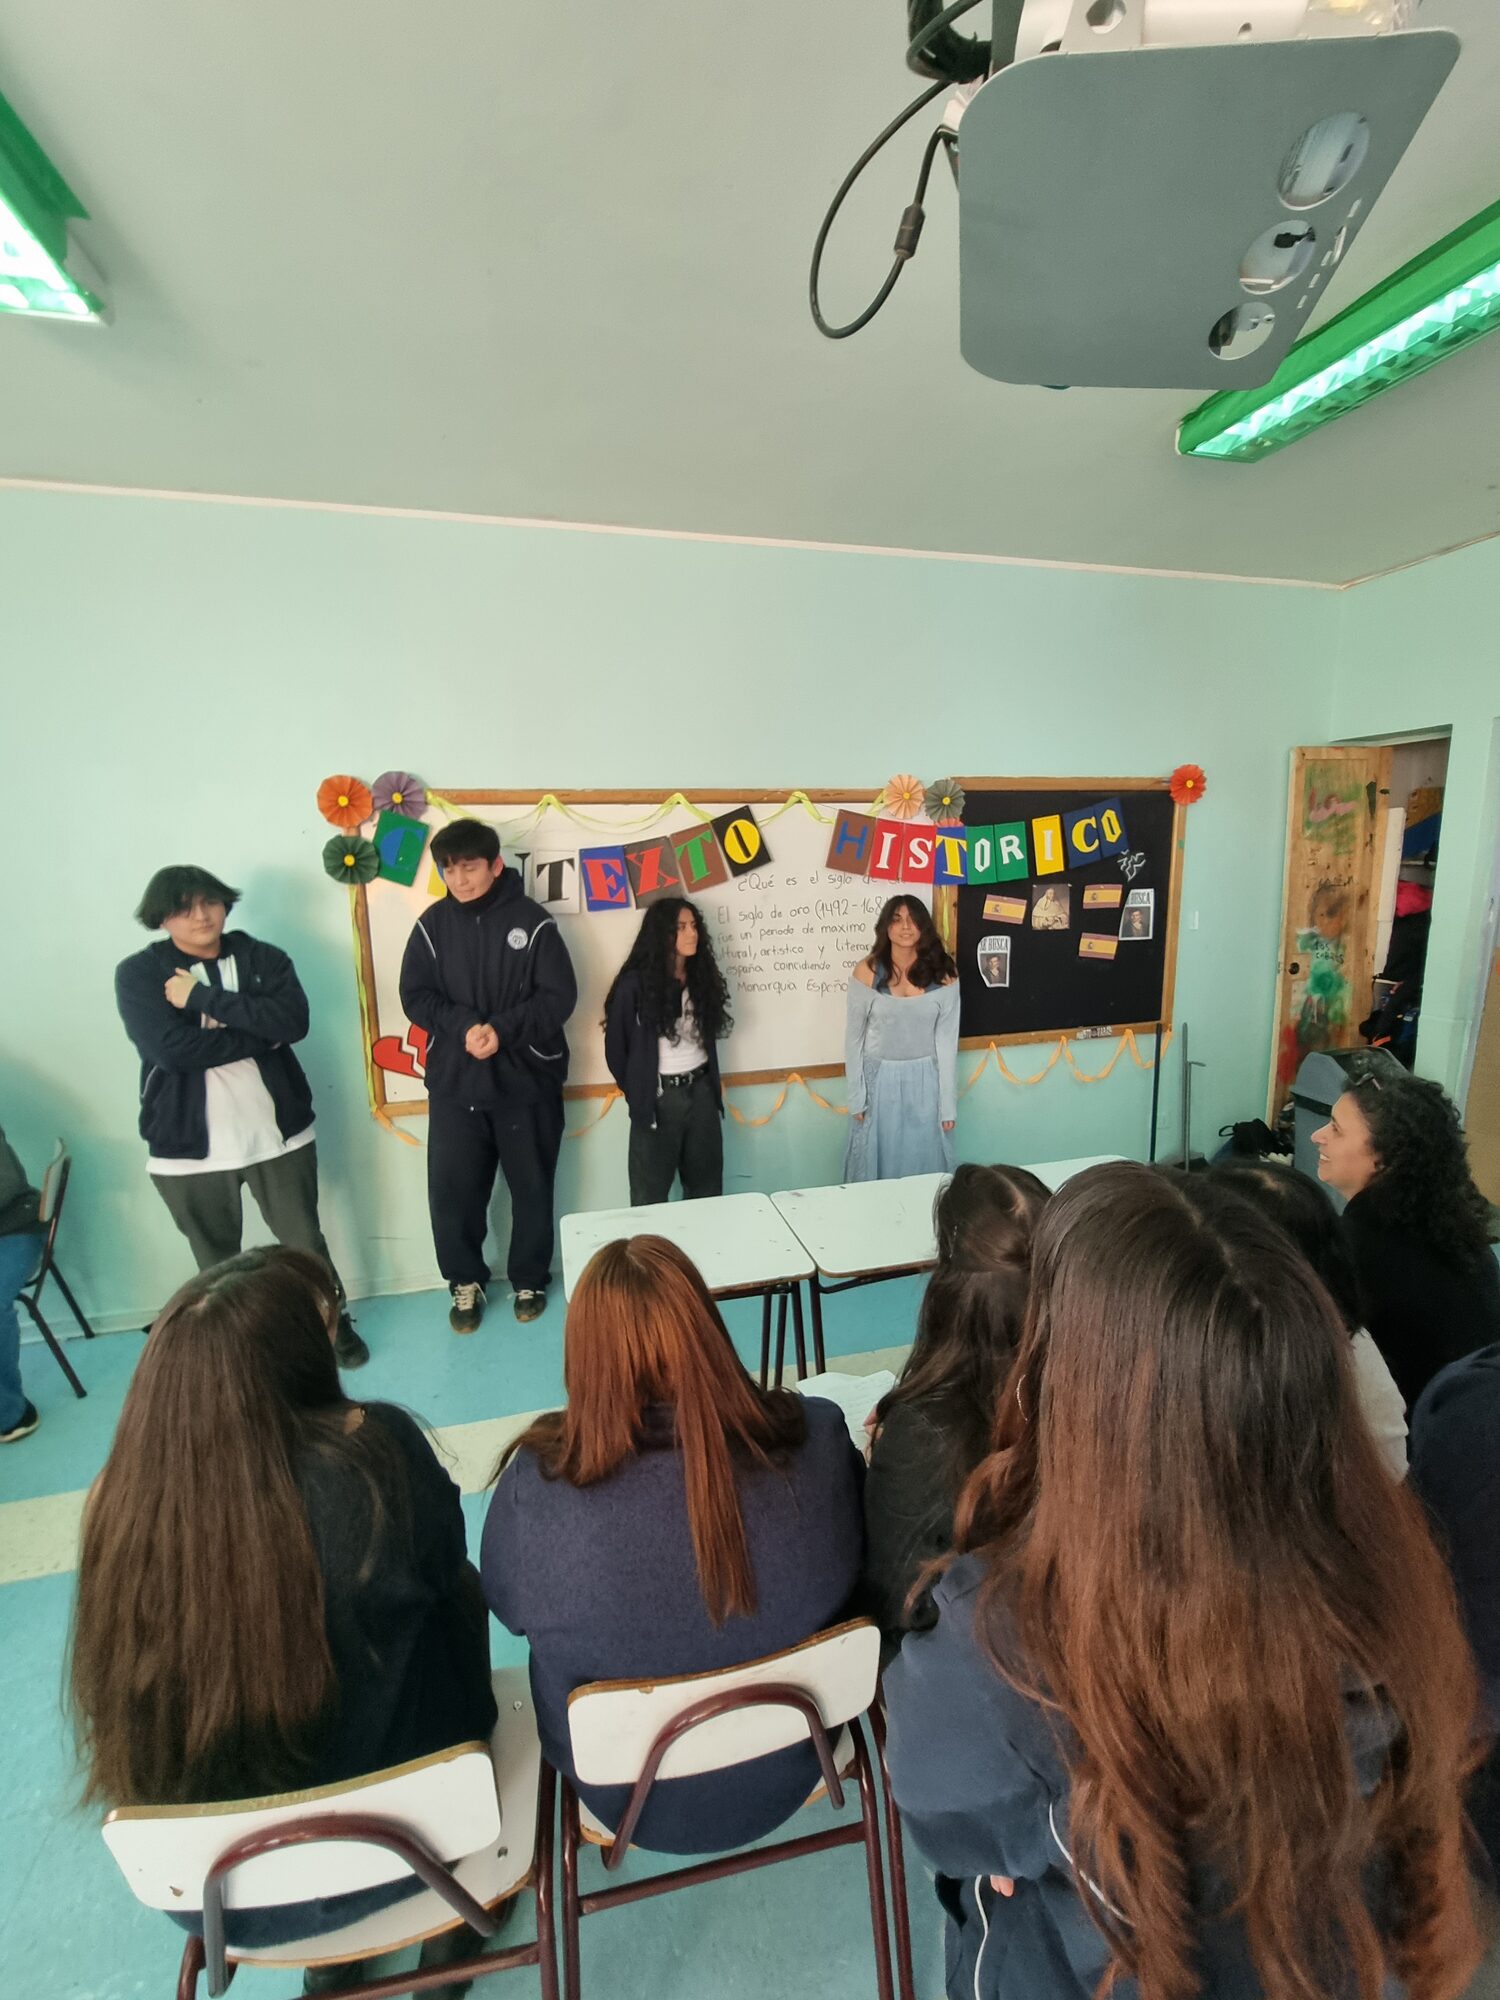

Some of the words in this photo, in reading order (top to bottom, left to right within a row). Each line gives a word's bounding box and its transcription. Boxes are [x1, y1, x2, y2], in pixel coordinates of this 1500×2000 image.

[380, 818, 761, 904] CTEXTO
[836, 808, 1122, 878] HISTORICO
[738, 872, 774, 891] ¿Qué
[786, 877, 798, 886] es
[809, 870, 819, 885] el
[827, 873, 852, 889] siglo
[718, 906, 730, 924] El
[738, 905, 764, 928] siglo
[770, 904, 782, 919] de
[789, 905, 810, 917] oro
[815, 896, 889, 920] (1492-168
[740, 932, 752, 940] un
[802, 923, 814, 934] de
[817, 945, 825, 960] y
[988, 937, 1008, 952] BUSCA
